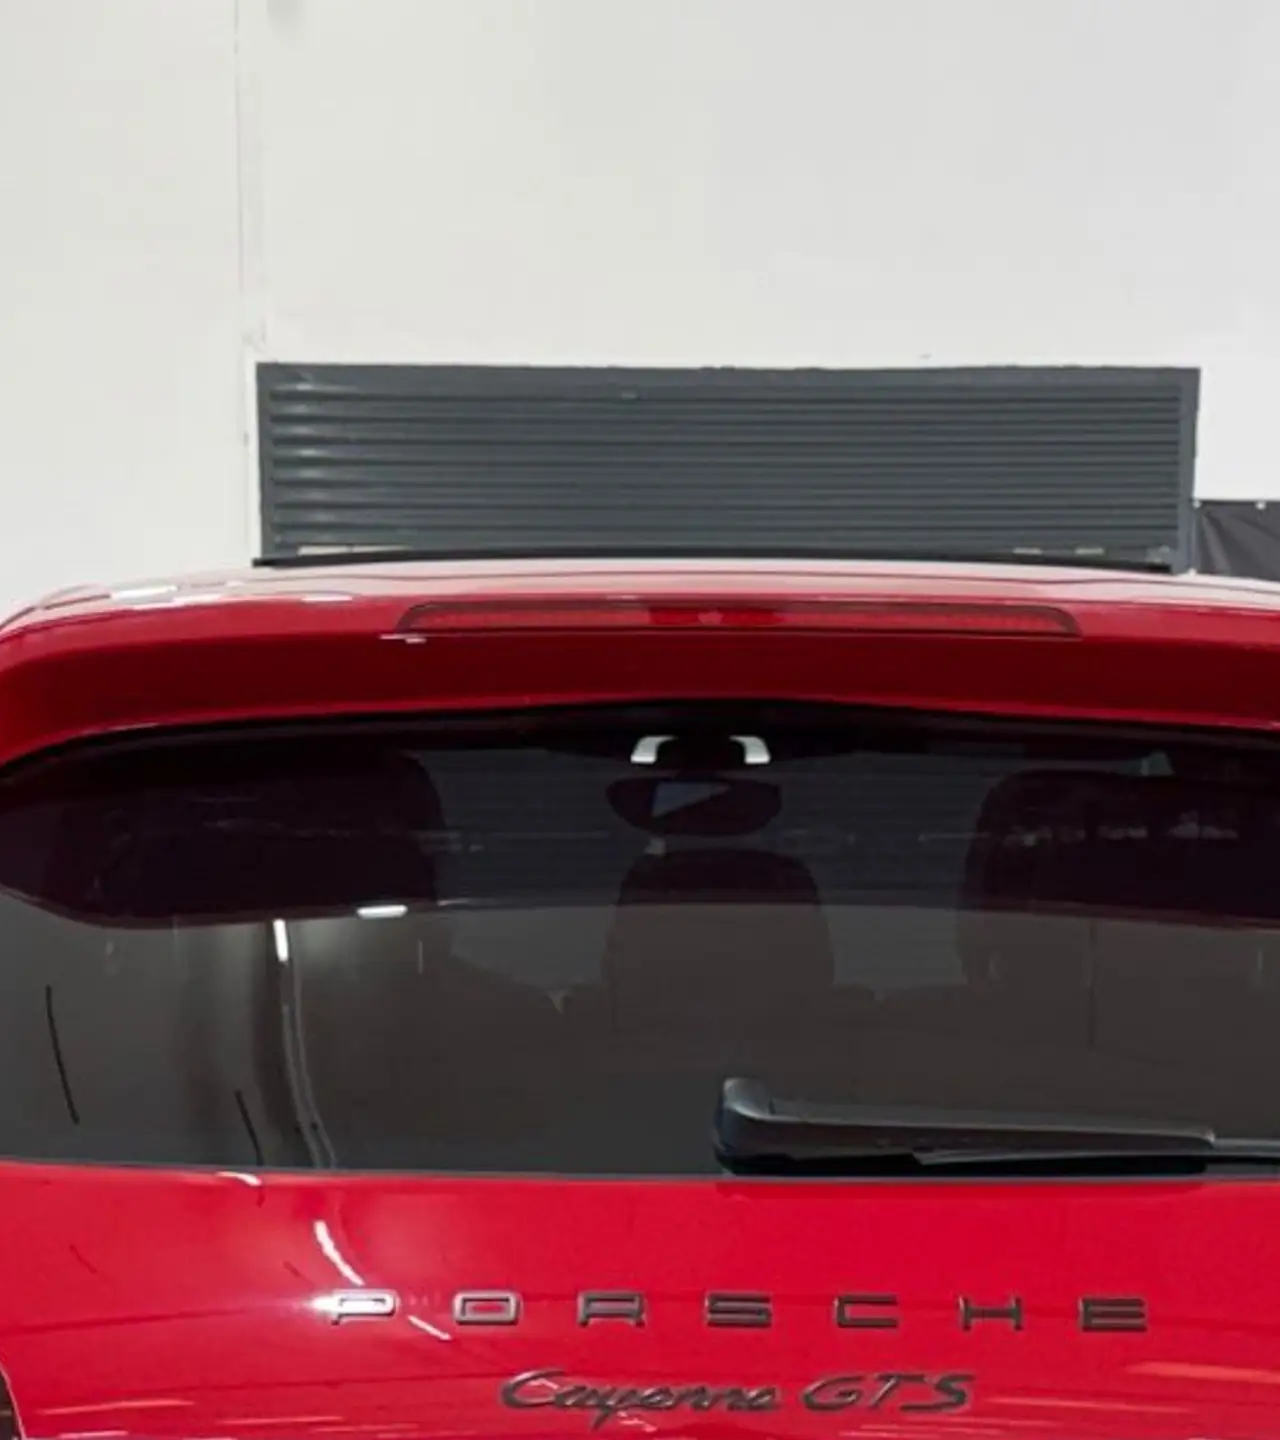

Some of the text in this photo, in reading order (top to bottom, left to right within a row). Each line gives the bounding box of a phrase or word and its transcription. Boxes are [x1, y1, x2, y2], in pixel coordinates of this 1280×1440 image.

[330, 1289, 1149, 1333] PORSCHE
[499, 1368, 975, 1431] Cayenne GTS
